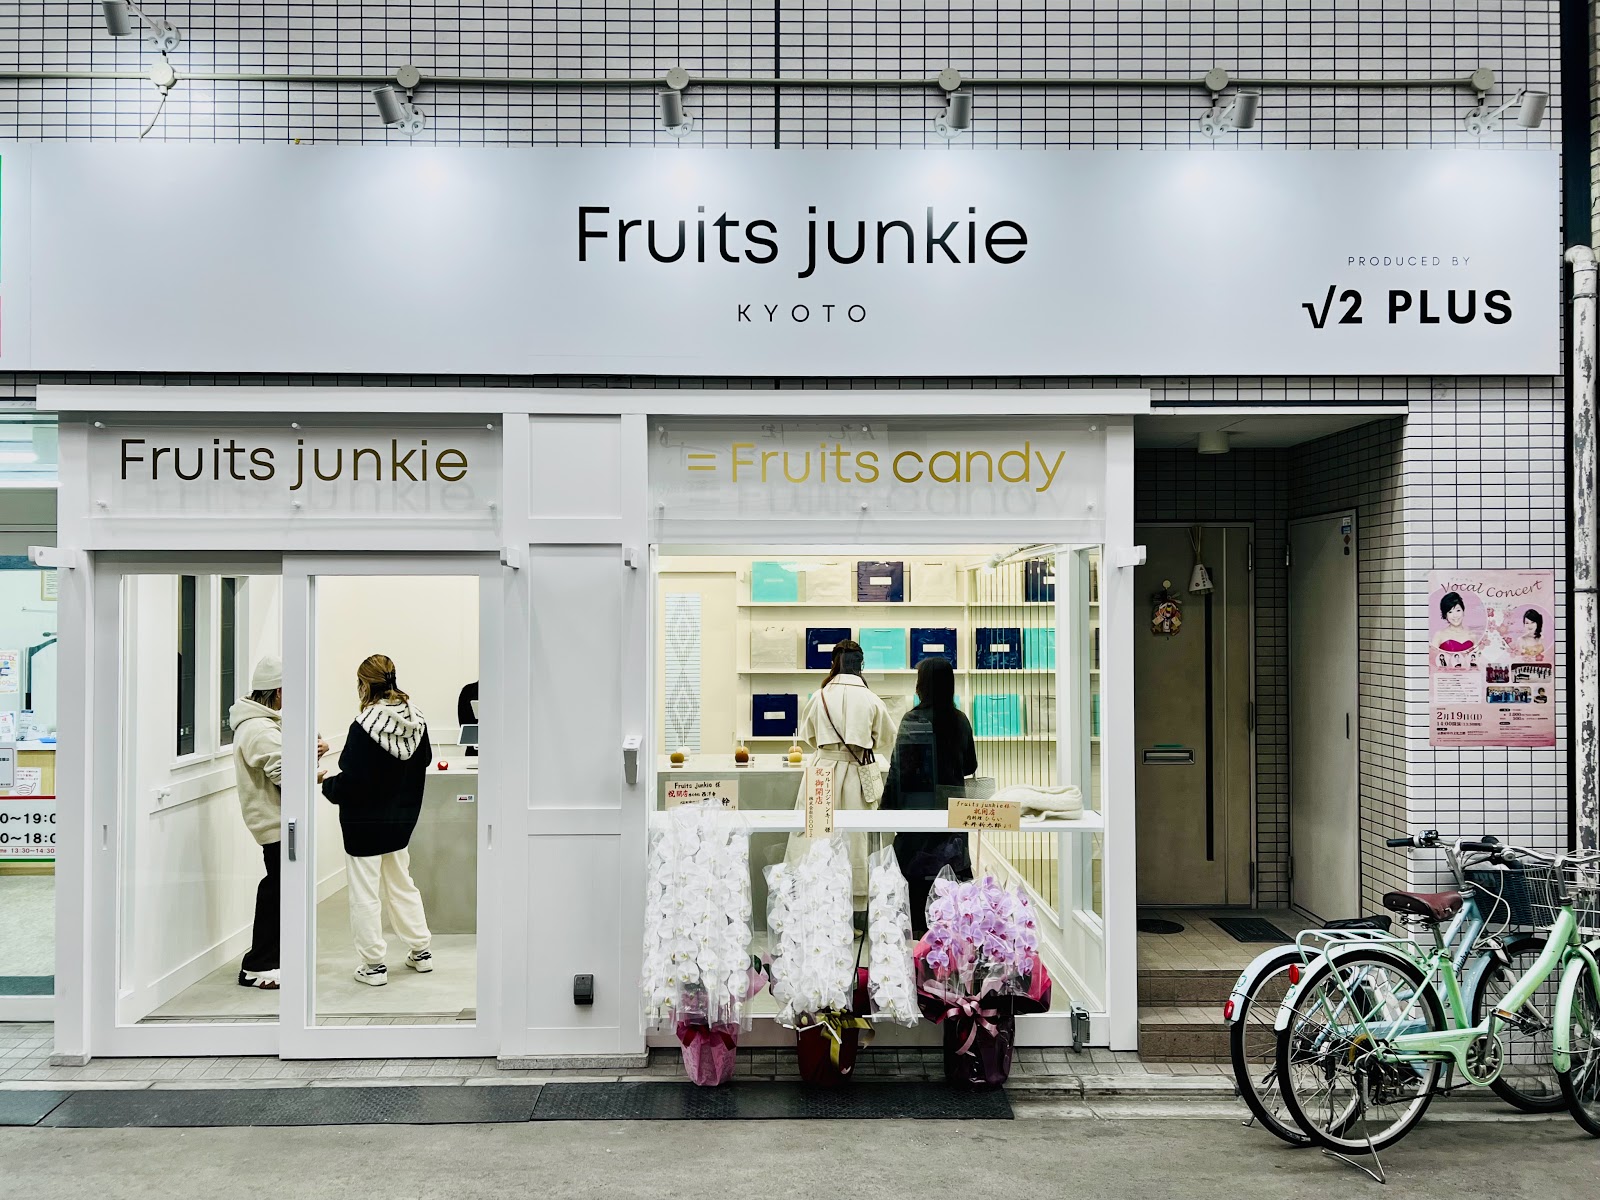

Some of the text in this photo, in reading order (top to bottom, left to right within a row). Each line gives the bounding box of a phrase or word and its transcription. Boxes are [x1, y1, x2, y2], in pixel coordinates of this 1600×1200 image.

[578, 205, 1029, 279] Fruits junkie
[1348, 256, 1471, 267] PRODUCED BY
[737, 304, 868, 323] KYOTO
[1388, 289, 1513, 325] PLUS
[120, 438, 468, 491] Fruits junkie
[731, 441, 880, 484] Fruits
[892, 441, 1066, 492] candy
[1441, 579, 1542, 598] Vocal Concert
[668, 789, 688, 798] 祝開店
[694, 781, 712, 790] junkie
[815, 767, 825, 805] 祝 御開店
[824, 771, 832, 825] フルーツジャンキー
[973, 808, 996, 816] 祝開店
